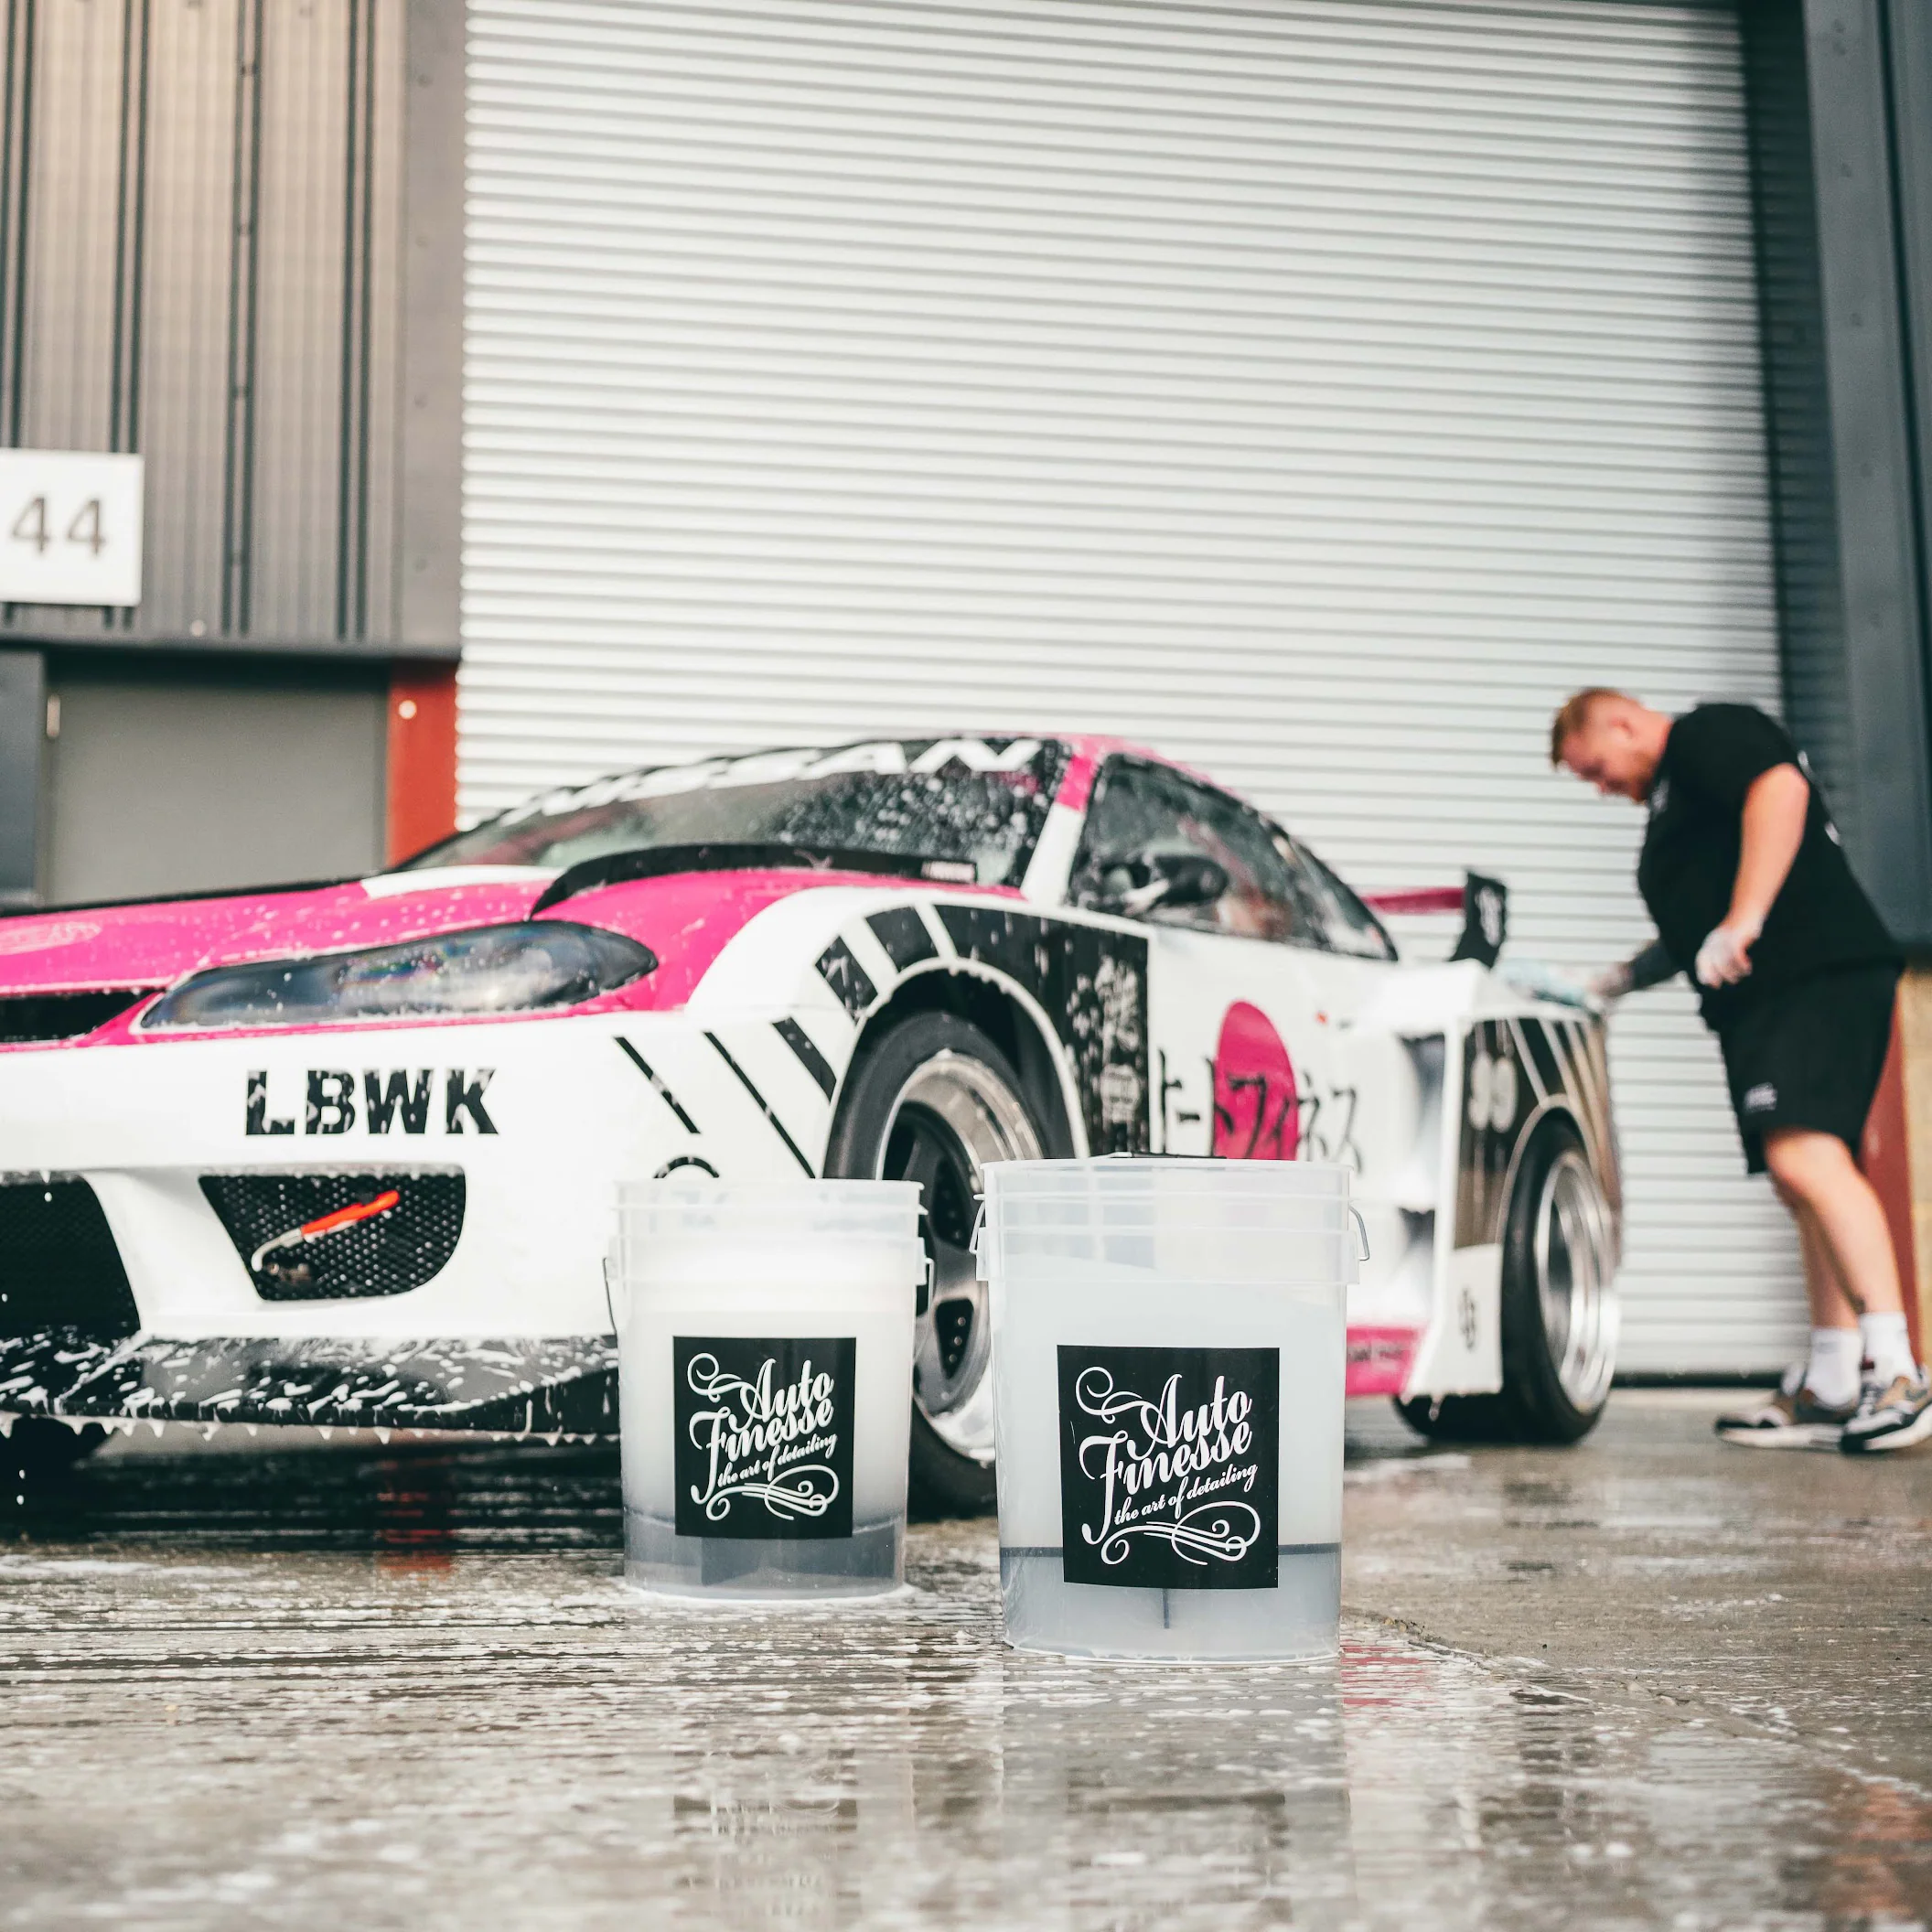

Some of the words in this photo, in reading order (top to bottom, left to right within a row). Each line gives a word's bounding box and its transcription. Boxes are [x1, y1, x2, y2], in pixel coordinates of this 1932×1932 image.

[11, 497, 107, 556] 44
[246, 1068, 499, 1135] LBWK
[687, 1353, 834, 1433] Auto
[1076, 1367, 1252, 1460] Auto
[689, 1398, 834, 1505] Finesse
[718, 1462, 738, 1487] the
[739, 1460, 760, 1479] art
[762, 1444, 780, 1481] of
[778, 1433, 838, 1460] detailing
[1079, 1422, 1252, 1545] Finesse
[1114, 1497, 1139, 1525] the
[1141, 1494, 1165, 1516] art
[1168, 1476, 1189, 1519] of
[1186, 1464, 1258, 1493] detailing
